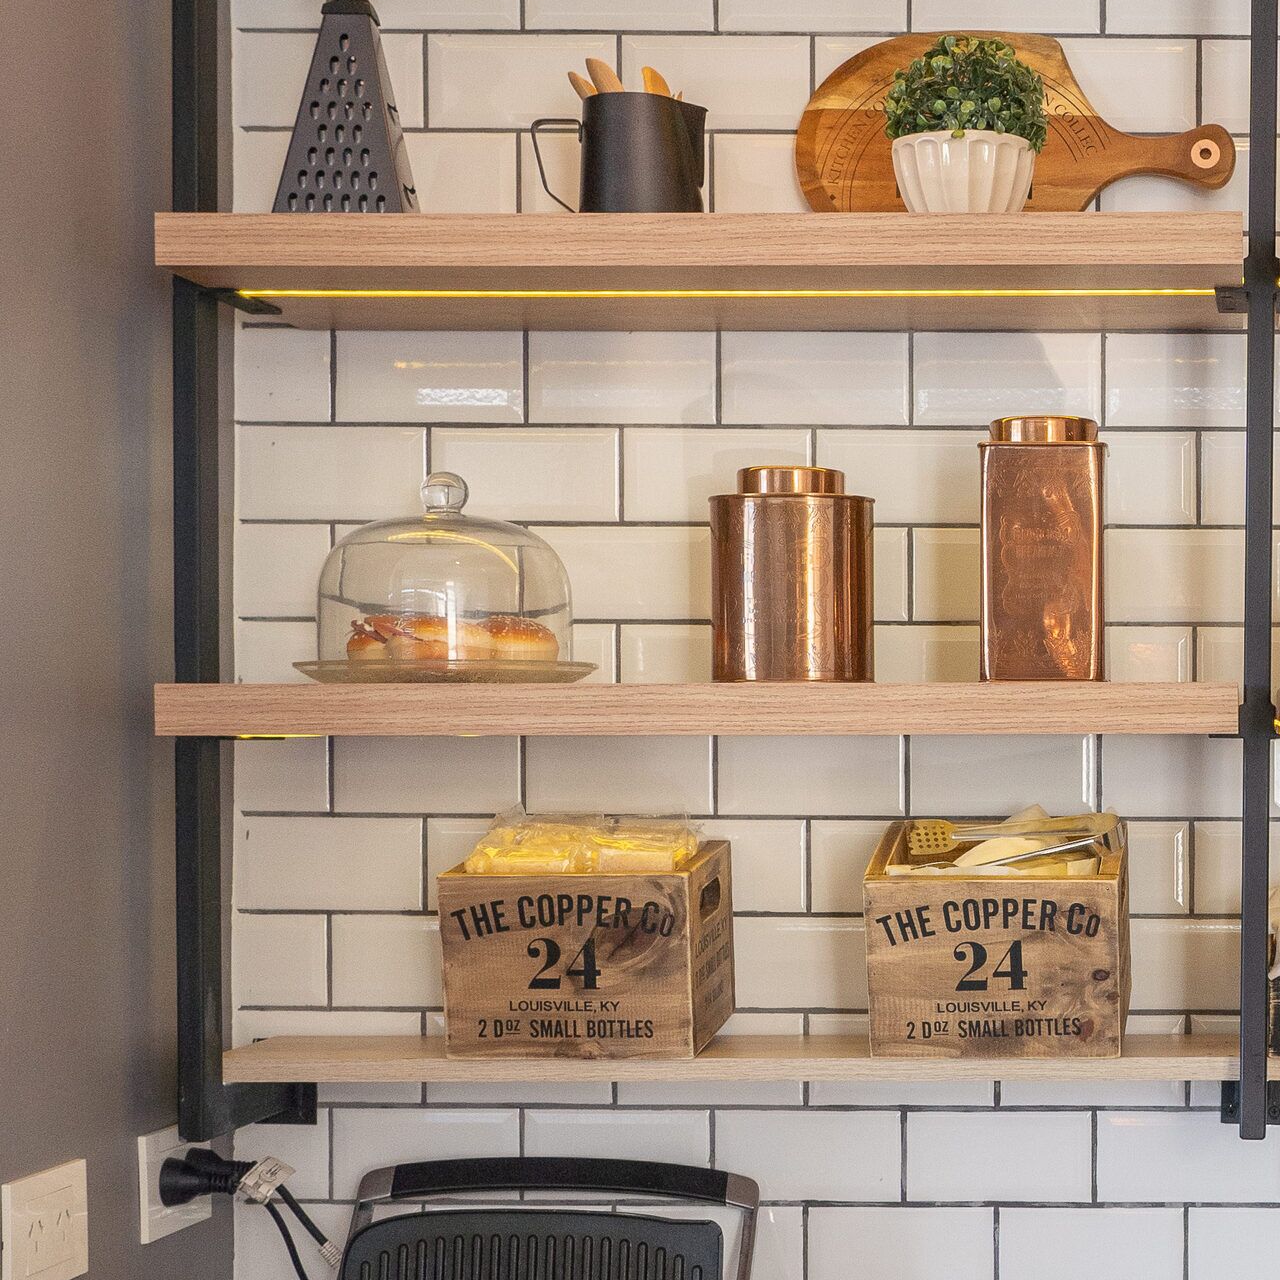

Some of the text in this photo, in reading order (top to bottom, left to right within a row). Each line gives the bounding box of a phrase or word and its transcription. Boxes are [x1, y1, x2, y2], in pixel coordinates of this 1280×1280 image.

[828, 120, 868, 185] KITCHEN
[450, 900, 510, 941] THE
[517, 893, 632, 930] COPPER
[875, 905, 937, 947] THE
[942, 897, 1058, 933] COPPER
[527, 937, 601, 990] 24
[953, 939, 1029, 992] 24
[478, 1020, 487, 1038] 2
[529, 1020, 582, 1038] SMALL
[586, 1020, 654, 1038] BOTTLES
[509, 1001, 620, 1013] LOUISVILLE, KY
[906, 1021, 916, 1040] 2
[958, 1020, 1010, 1039] SMALL
[1014, 1017, 1082, 1037] BOTTLES
[937, 1000, 1048, 1014] LOUISVILLE, KY
